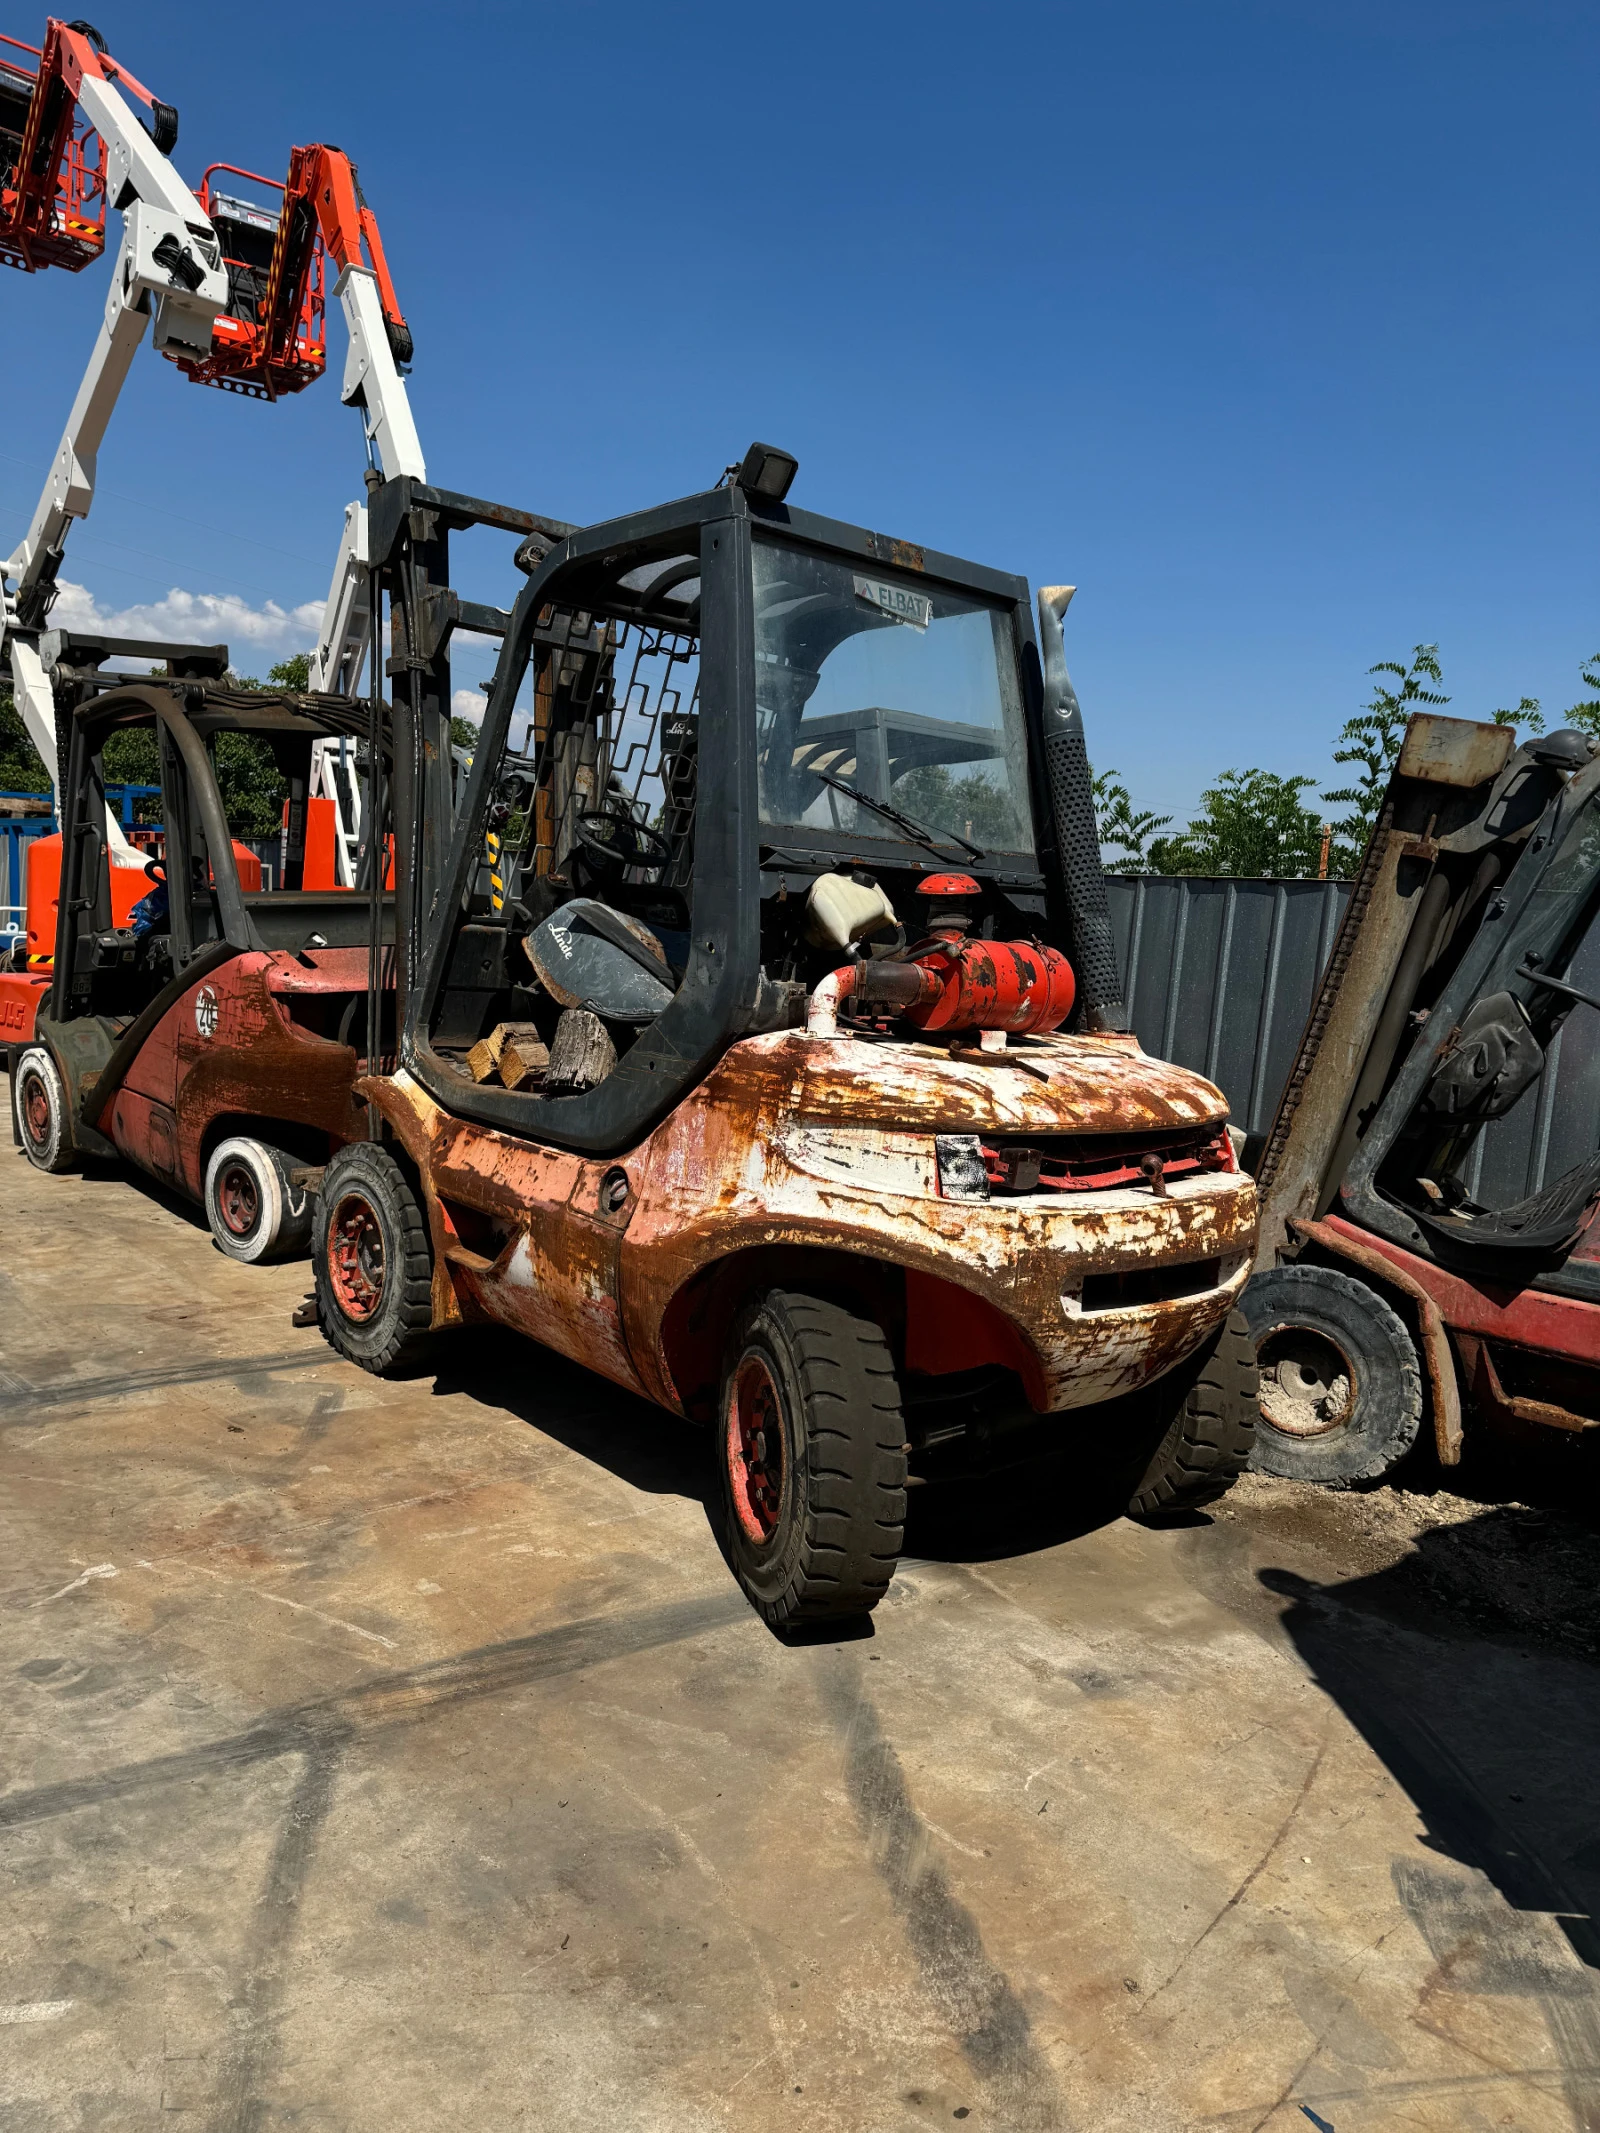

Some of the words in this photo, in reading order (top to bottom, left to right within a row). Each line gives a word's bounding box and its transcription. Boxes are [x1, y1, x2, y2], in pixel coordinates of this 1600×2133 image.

[879, 586, 922, 617] ELBAT
[665, 722, 694, 736] Line
[548, 923, 573, 960] Linde
